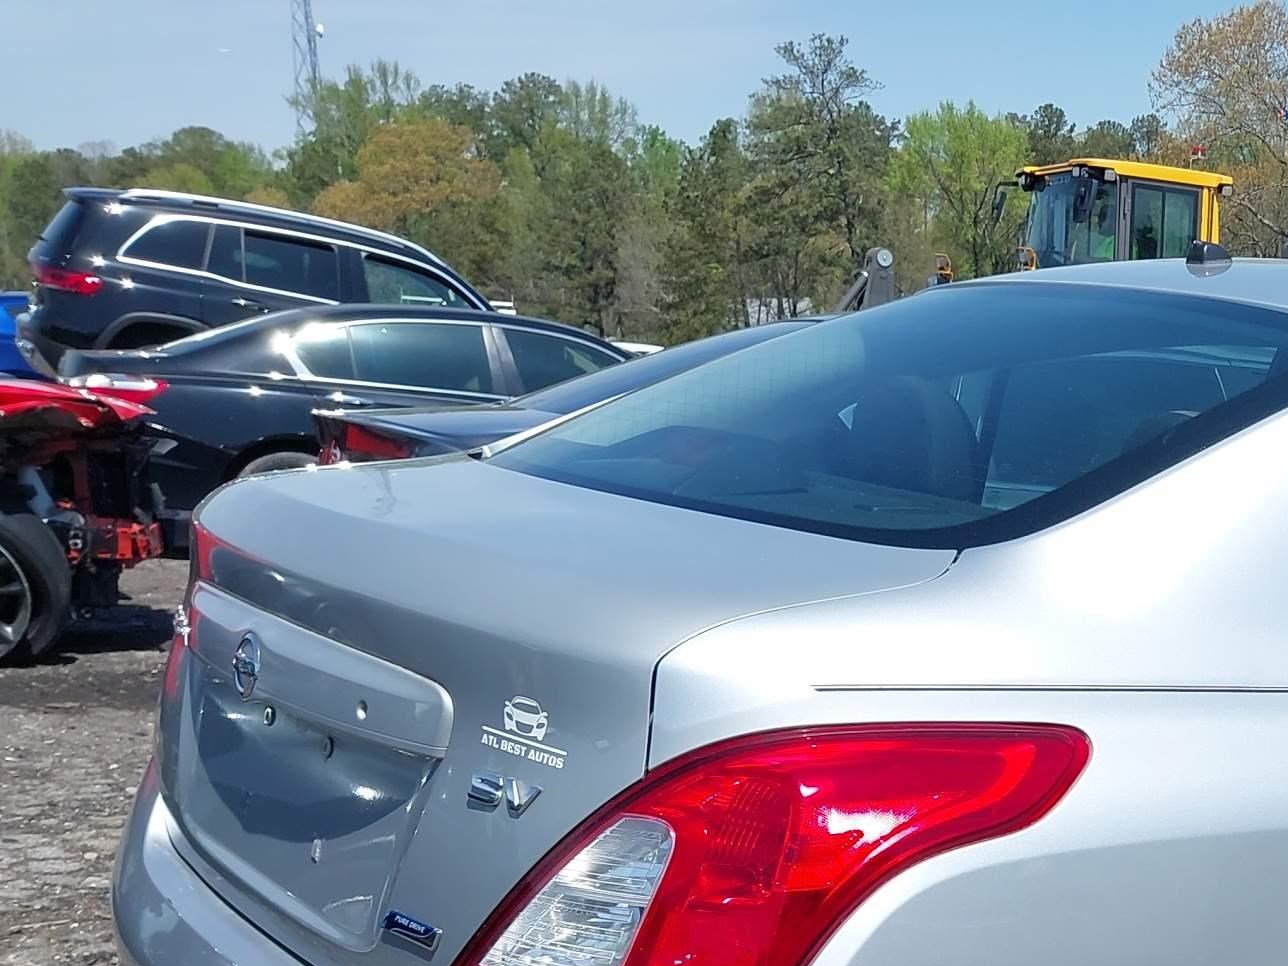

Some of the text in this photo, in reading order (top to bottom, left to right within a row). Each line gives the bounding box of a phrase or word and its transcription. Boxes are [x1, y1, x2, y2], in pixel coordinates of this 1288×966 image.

[481, 733, 565, 769] ATL BEST AUTOS
[467, 774, 543, 819] SV
